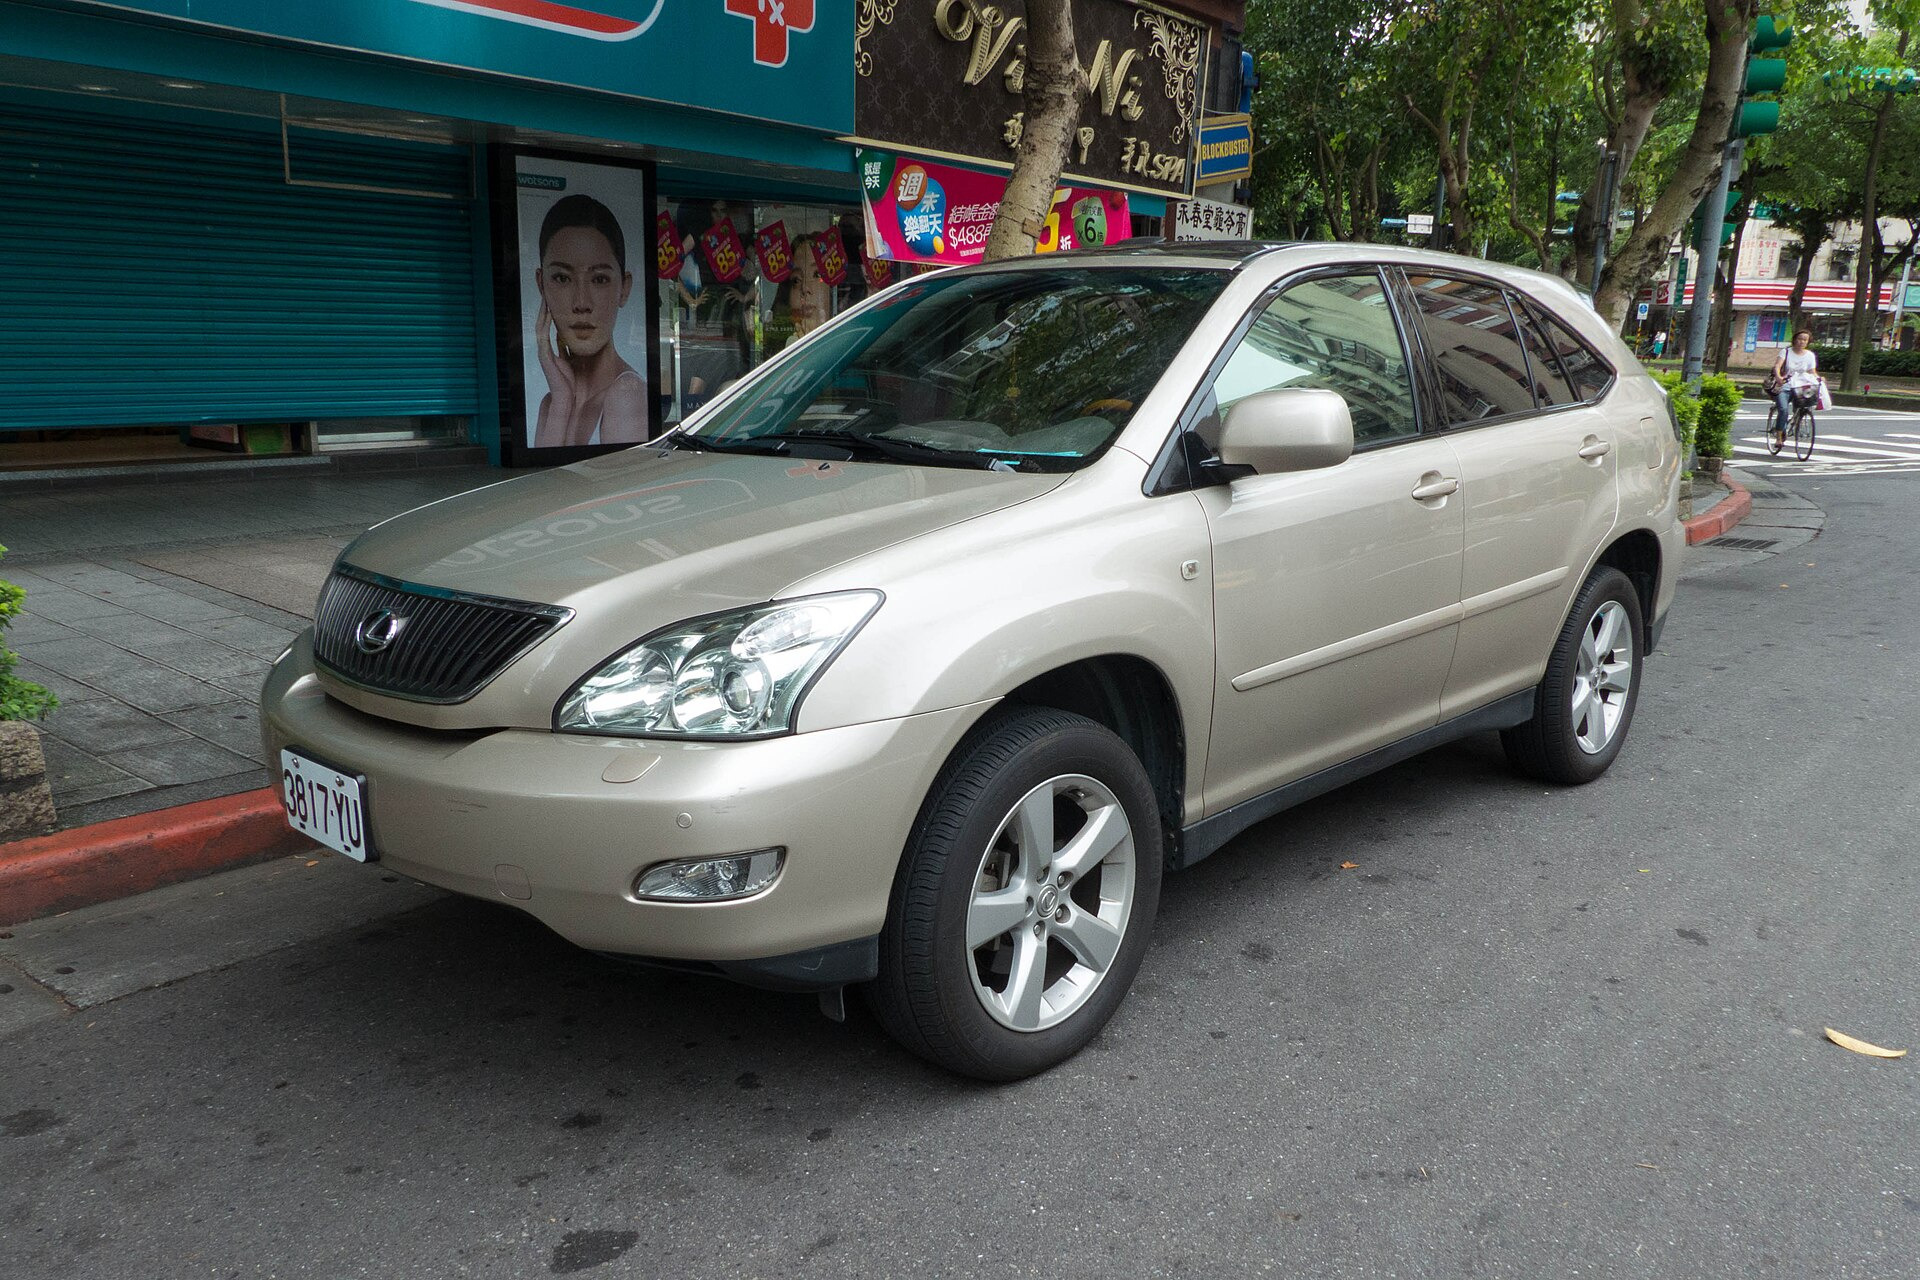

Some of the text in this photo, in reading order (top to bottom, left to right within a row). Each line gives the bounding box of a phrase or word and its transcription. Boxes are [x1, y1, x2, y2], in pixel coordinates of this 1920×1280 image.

[1202, 139, 1249, 160] BLOCKBUSTER
[864, 162, 881, 175] 就是
[865, 176, 880, 189] 今天
[1177, 202, 1247, 237] 永春堂龜苓膏
[284, 768, 362, 849] 3817-YU
